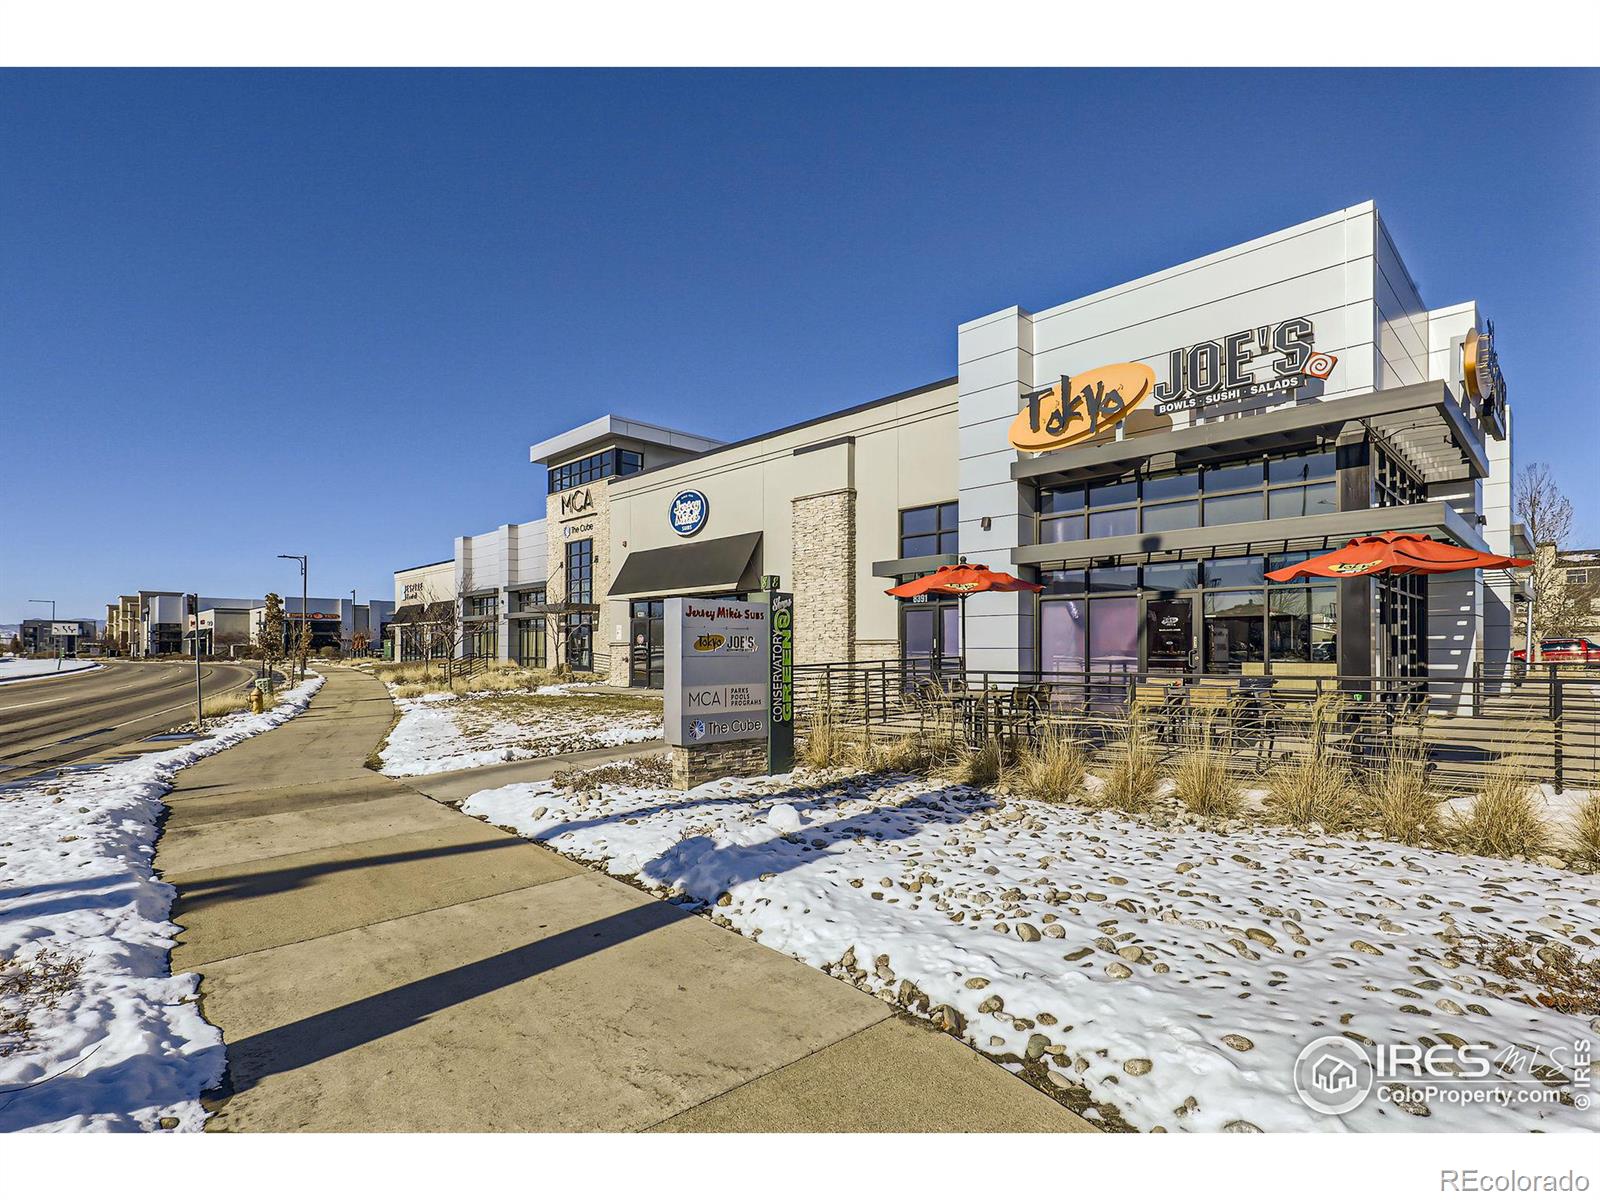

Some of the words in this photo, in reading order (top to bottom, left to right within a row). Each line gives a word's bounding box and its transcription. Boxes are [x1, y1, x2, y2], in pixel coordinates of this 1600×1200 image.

[1020, 375, 1124, 436] Tokyo
[1154, 316, 1316, 403] JOE'S
[1159, 399, 1196, 413] BOWLS
[1205, 389, 1241, 404] SUSHI
[1250, 377, 1299, 395] SALADS
[561, 487, 594, 515] MCA
[686, 605, 716, 621] Jersey
[697, 633, 722, 652] Tokyo
[727, 635, 755, 649] JOE'S
[772, 630, 783, 722] CONSERVATORY
[782, 629, 792, 722] GREEN
[688, 691, 721, 707] MCA
[730, 699, 762, 707] PROGRAMS
[708, 721, 730, 735] The
[731, 719, 763, 733] Cube
